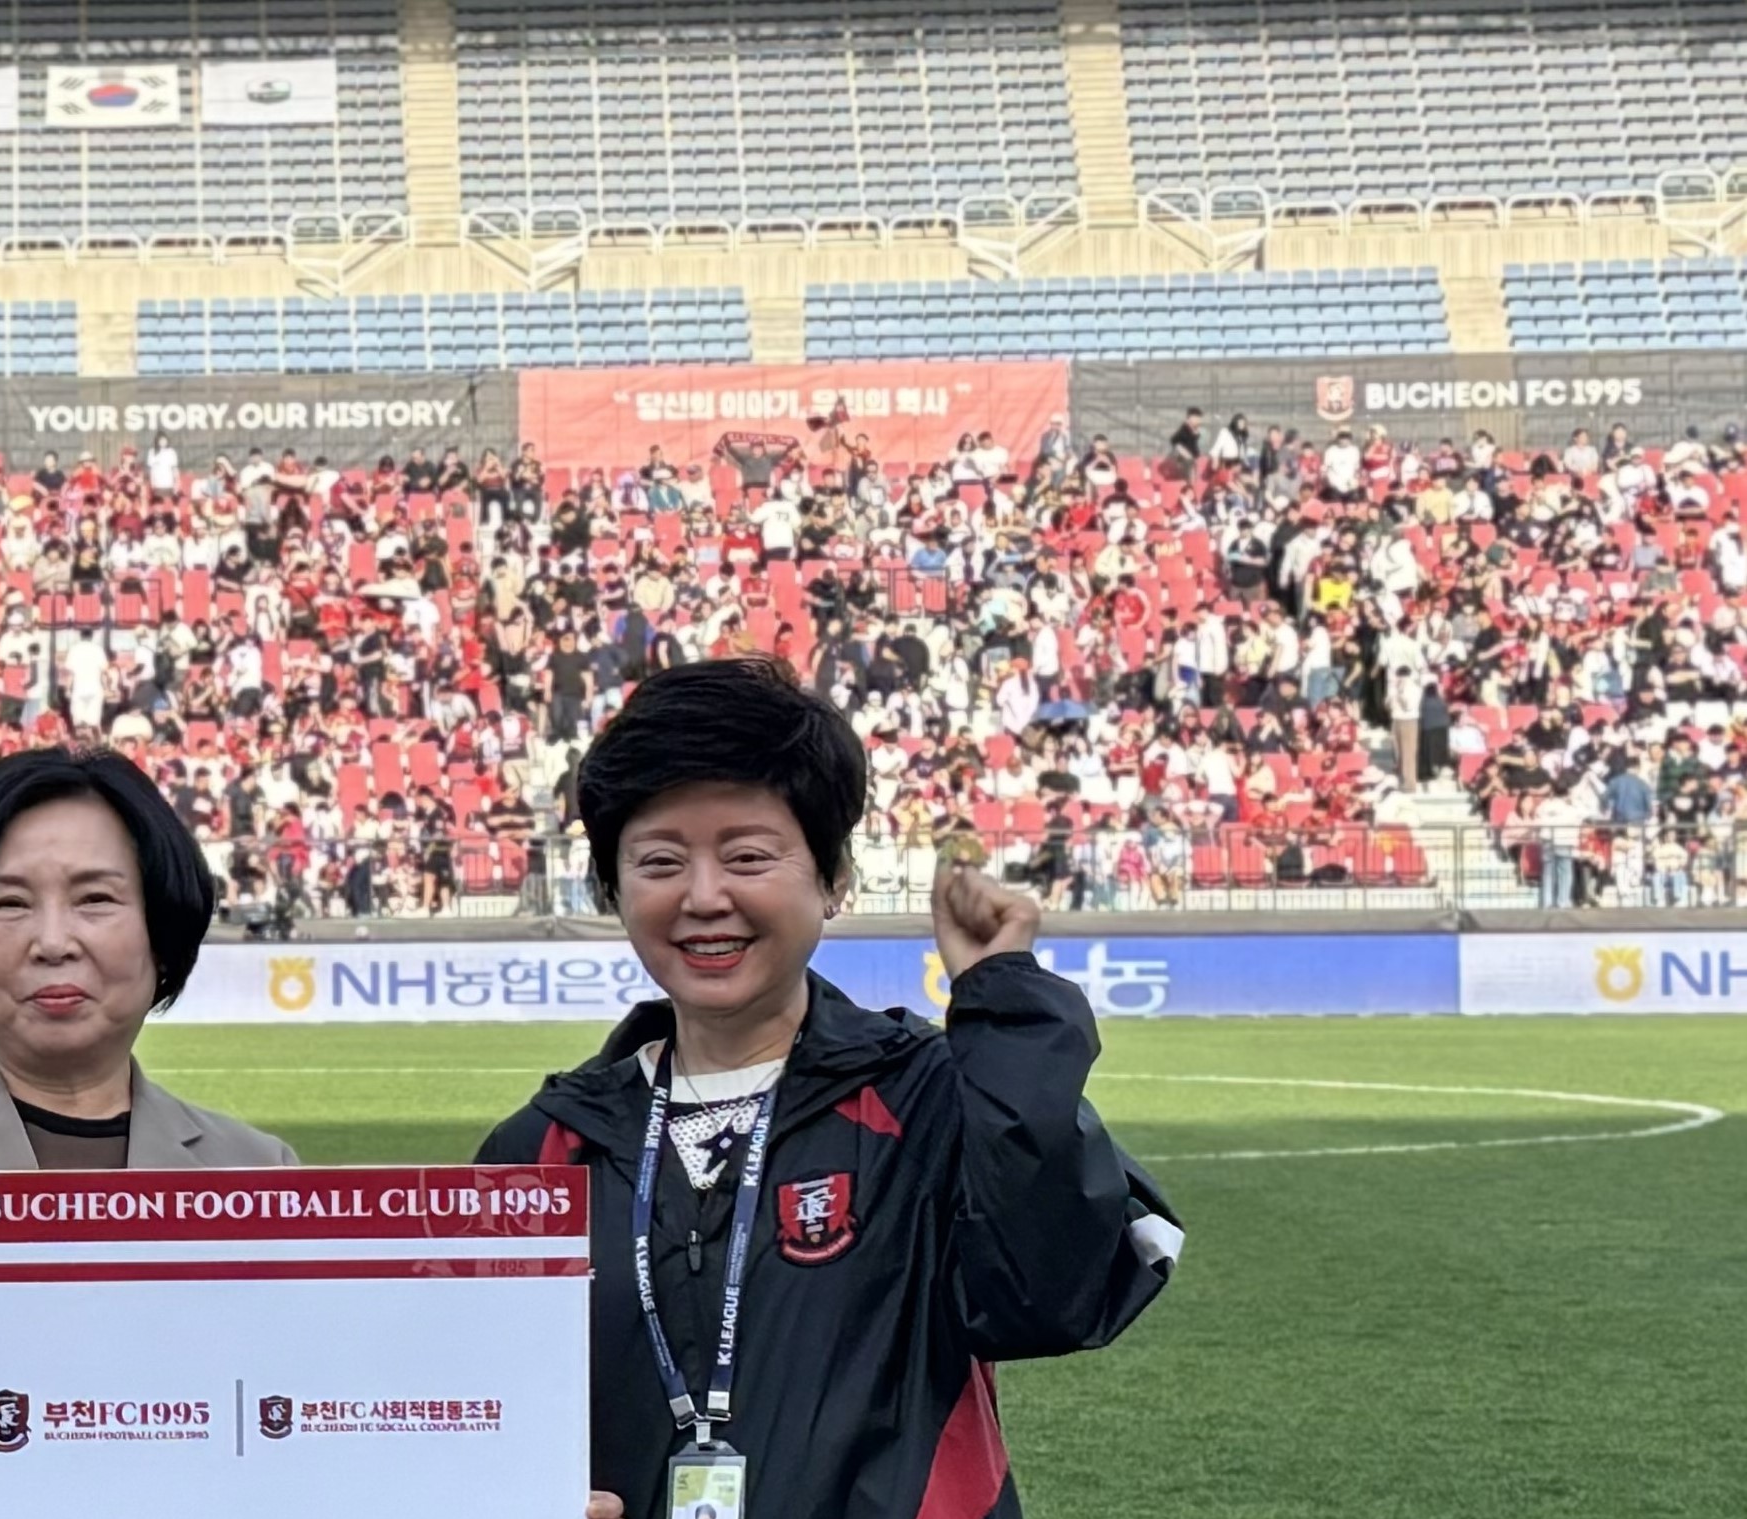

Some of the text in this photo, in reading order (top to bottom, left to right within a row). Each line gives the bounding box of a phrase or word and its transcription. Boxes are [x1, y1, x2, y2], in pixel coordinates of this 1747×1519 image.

[1365, 377, 1642, 410] BUCHEON FC 1995
[29, 404, 119, 432] YOUR
[314, 400, 463, 428] HISTORY.
[652, 1086, 668, 1100] K
[644, 1099, 667, 1149] LEAGUE
[742, 1115, 770, 1187] K LEAGUE
[175, 1189, 373, 1220] FOOTBALL
[379, 1187, 482, 1217] CLUB
[489, 1186, 572, 1216] 1995
[635, 1234, 656, 1312] K LEAGUE
[719, 1286, 740, 1350] LEAGUE
[716, 1350, 733, 1367] K
[42, 1400, 211, 1429] 부천FC1995
[300, 1399, 503, 1421] 부천FC 사회적협동조합
[419, 1421, 502, 1432] COOPERATIVE
